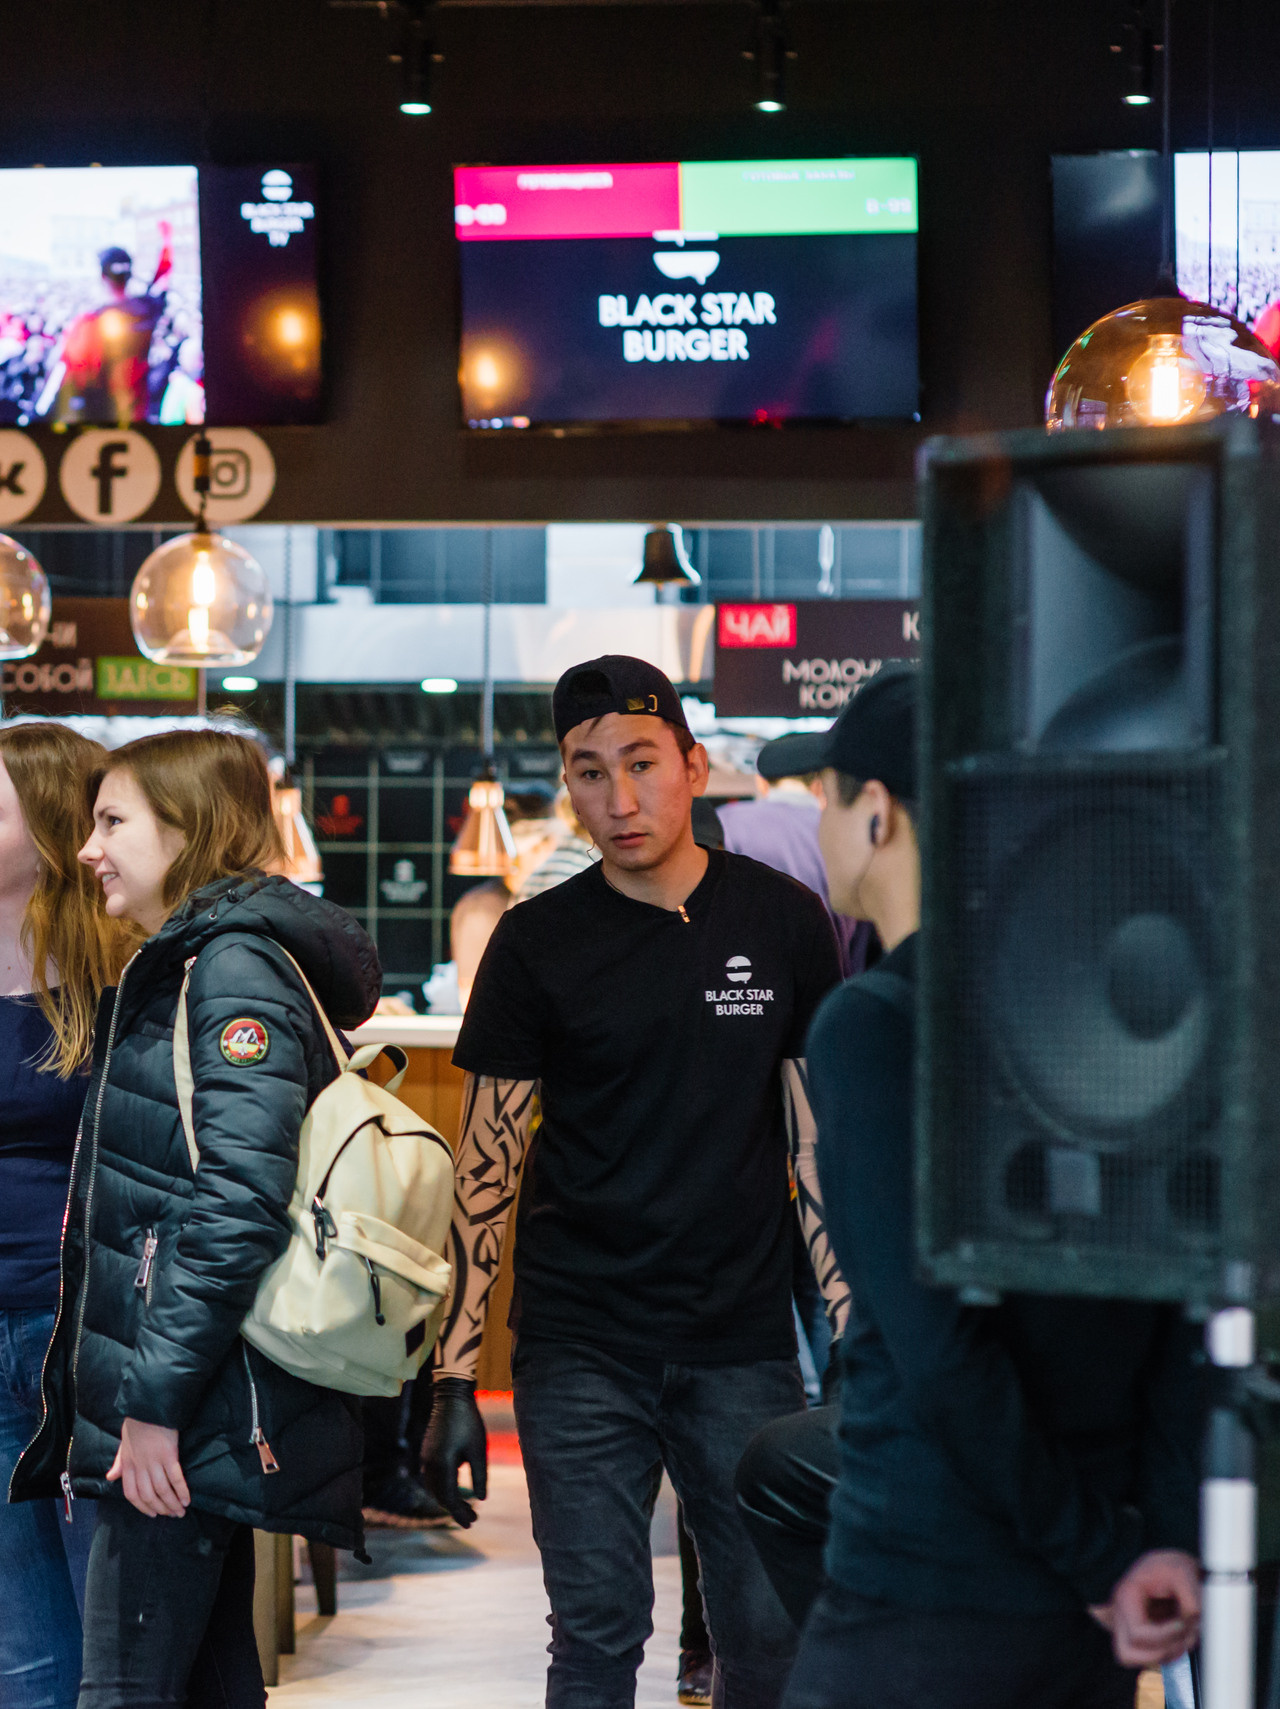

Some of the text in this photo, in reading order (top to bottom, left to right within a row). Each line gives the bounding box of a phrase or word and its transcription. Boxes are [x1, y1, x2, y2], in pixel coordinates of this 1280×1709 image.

[598, 292, 777, 327] BLACK STAR
[623, 328, 750, 362] BURGER
[724, 604, 791, 643] ЧАЙ
[782, 658, 884, 684] МОЛОЧ
[799, 684, 860, 710] КОК
[705, 989, 774, 1002] BLACK STAR
[715, 1003, 764, 1016] BURGER
